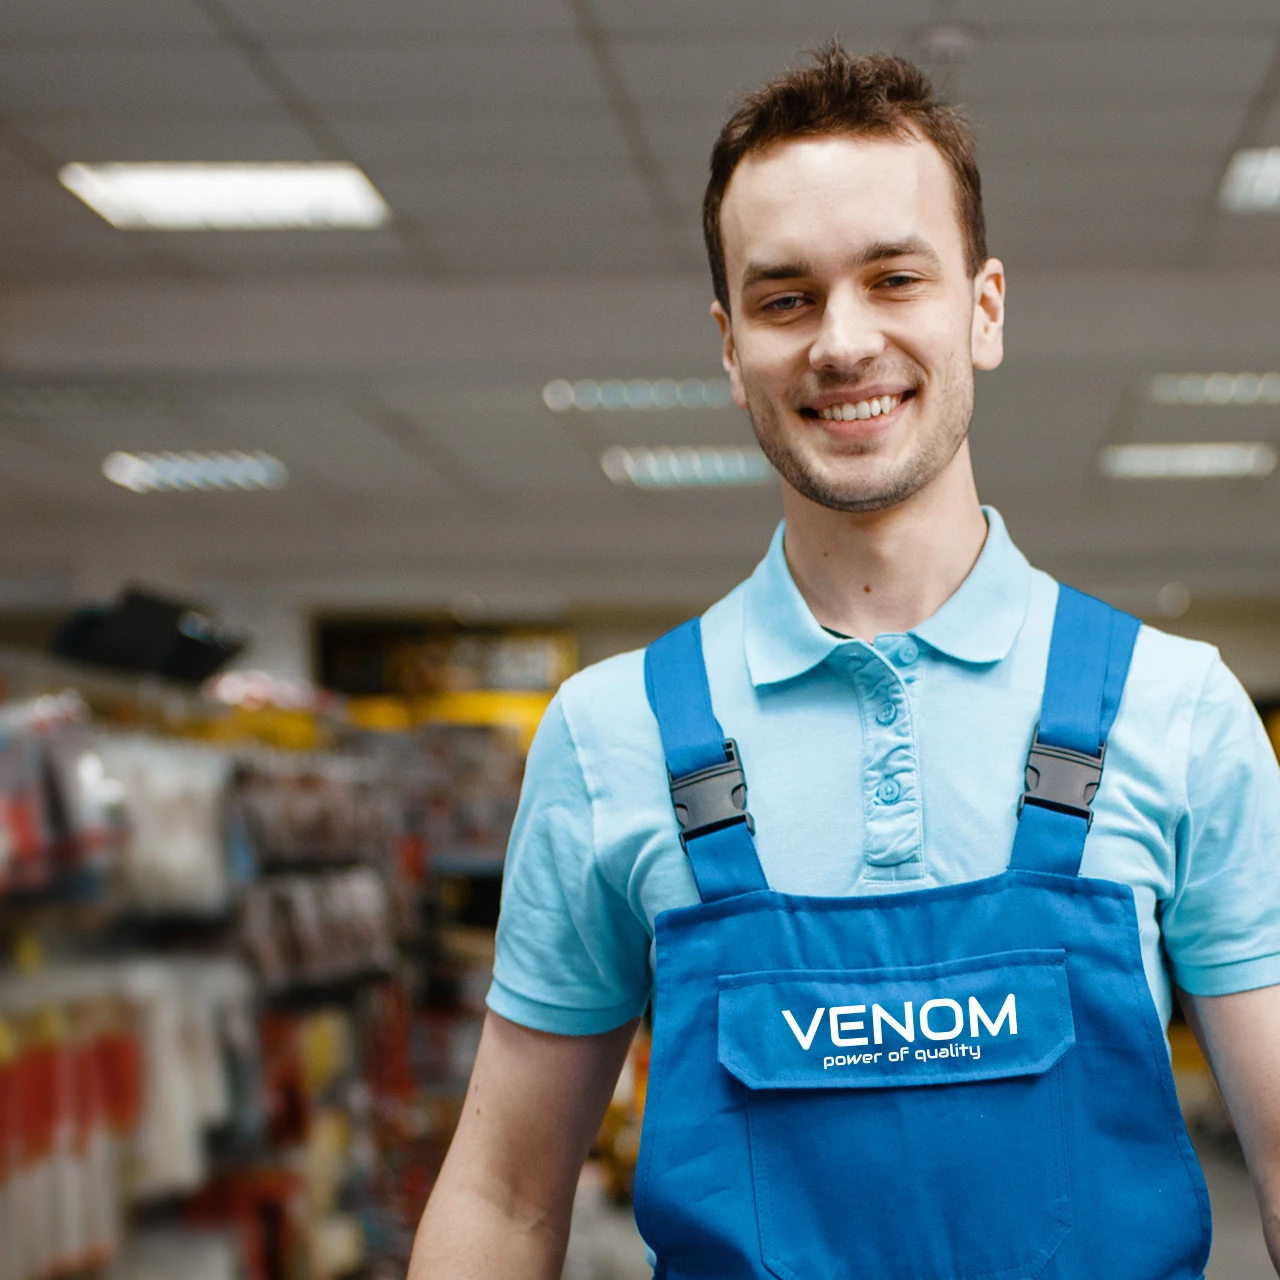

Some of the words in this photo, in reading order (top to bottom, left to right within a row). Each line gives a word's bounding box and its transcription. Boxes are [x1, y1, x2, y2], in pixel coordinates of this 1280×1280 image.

[781, 993, 1018, 1051] VENOM
[823, 1052, 883, 1070] power
[888, 1046, 910, 1062] of
[915, 1043, 981, 1063] quality
